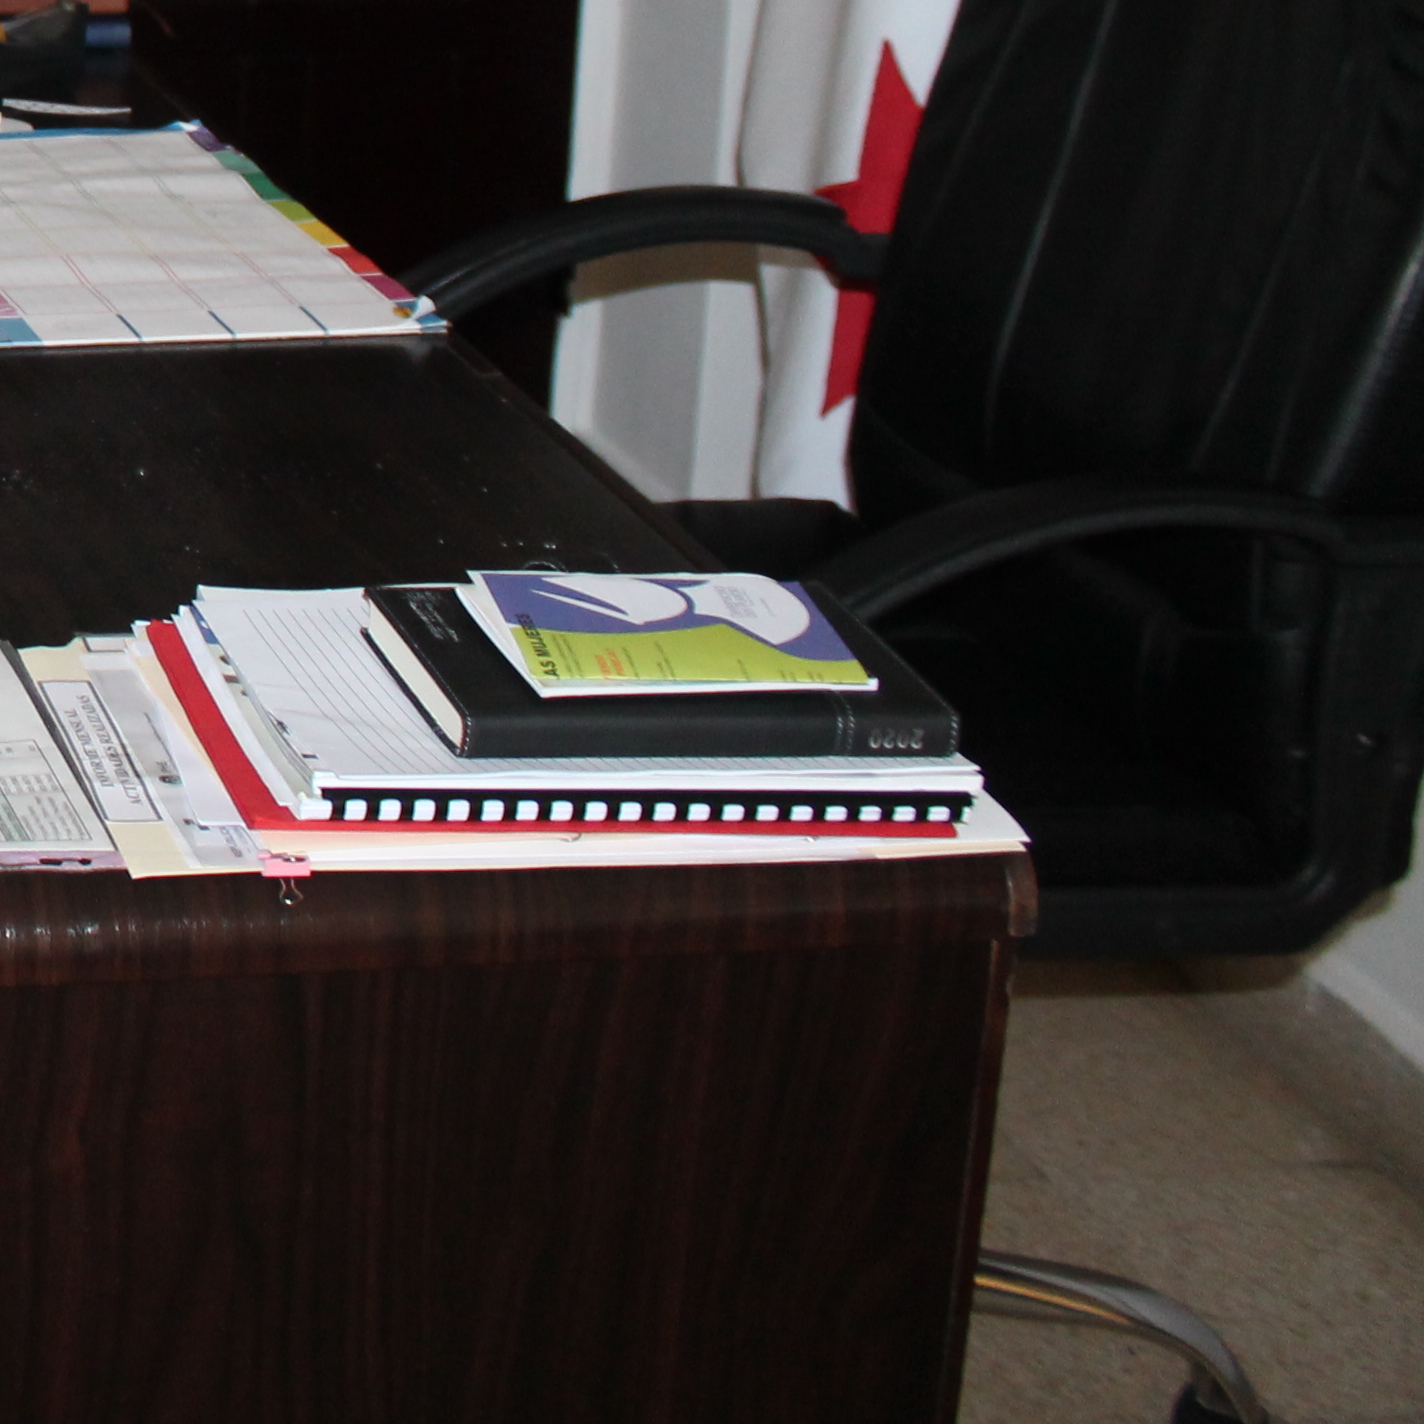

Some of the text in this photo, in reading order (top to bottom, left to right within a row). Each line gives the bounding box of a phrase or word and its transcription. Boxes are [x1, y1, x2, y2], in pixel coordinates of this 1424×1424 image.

[515, 613, 553, 658] MUJERES
[64, 709, 113, 788] INFORME MENSUAL
[77, 694, 143, 806] ACTIVIDADES REALIZADAS
[867, 727, 924, 749] 2020
